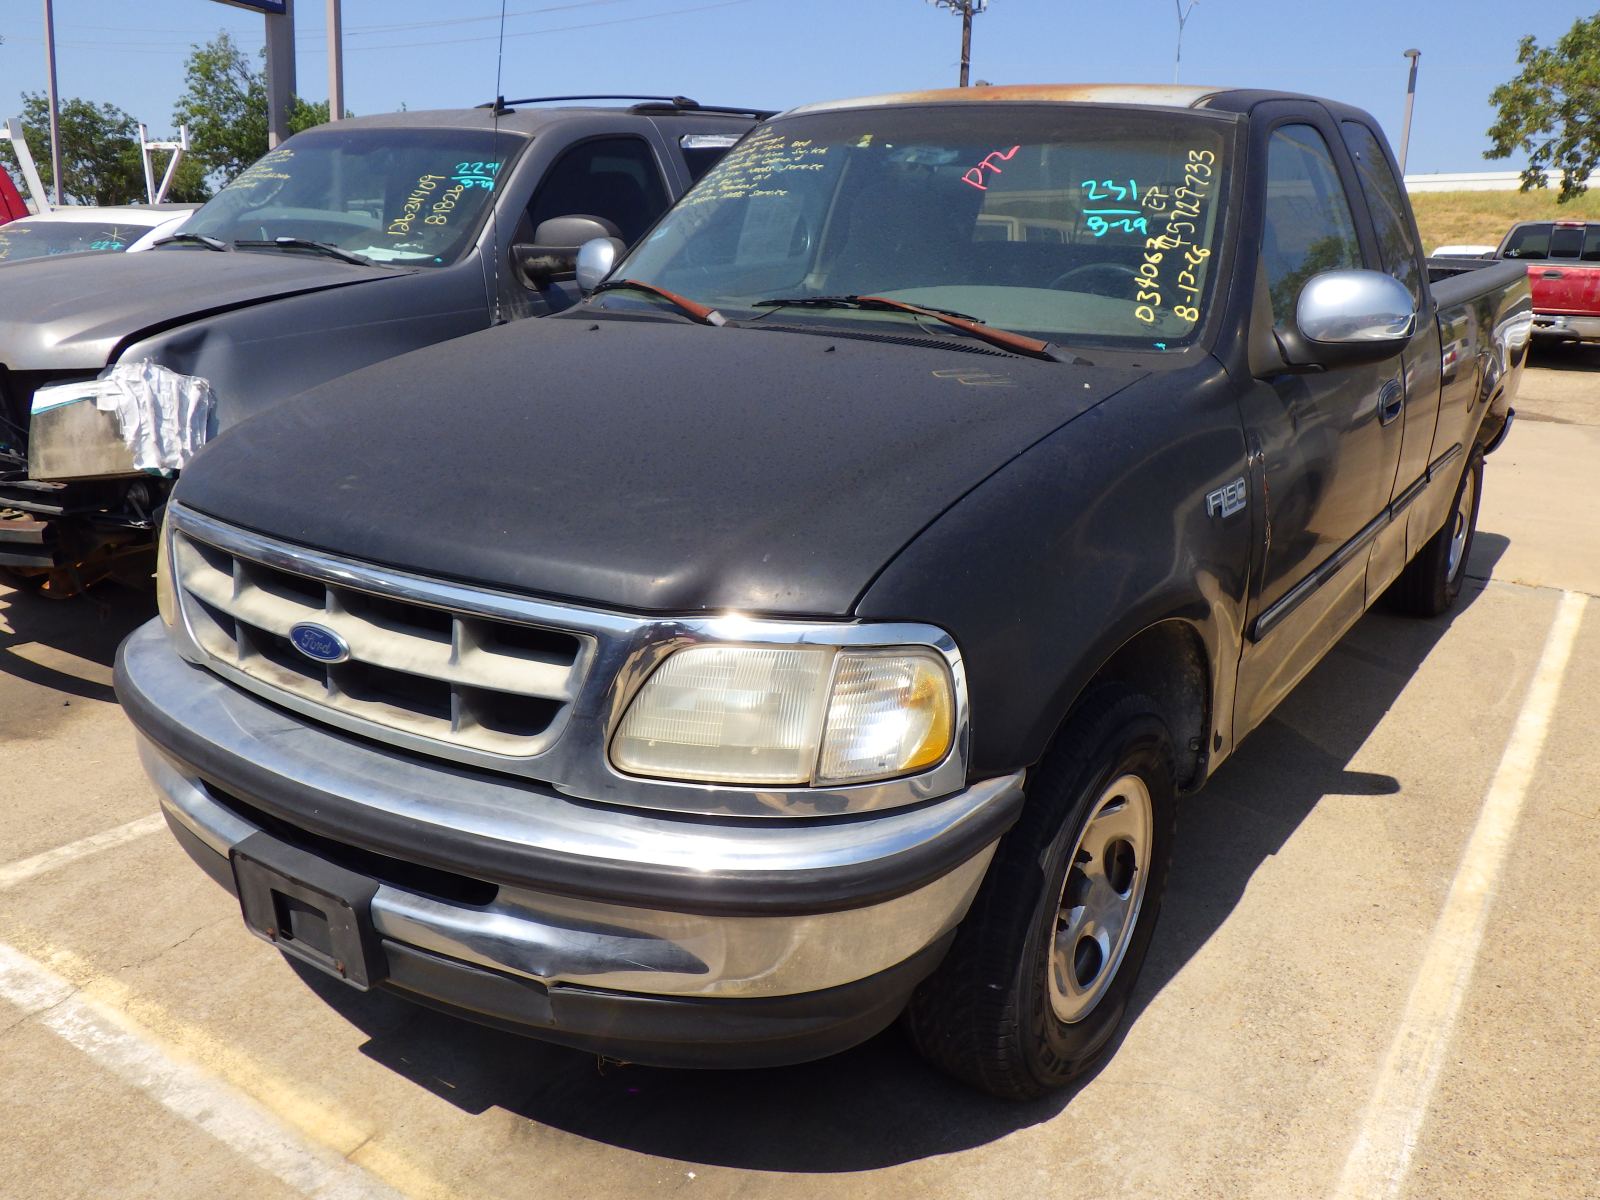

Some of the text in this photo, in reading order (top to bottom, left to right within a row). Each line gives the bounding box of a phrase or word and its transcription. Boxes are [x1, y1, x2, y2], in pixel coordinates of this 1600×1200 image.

[455, 162, 499, 176] 229
[1082, 179, 1137, 200] 231
[300, 629, 333, 655] Ford
